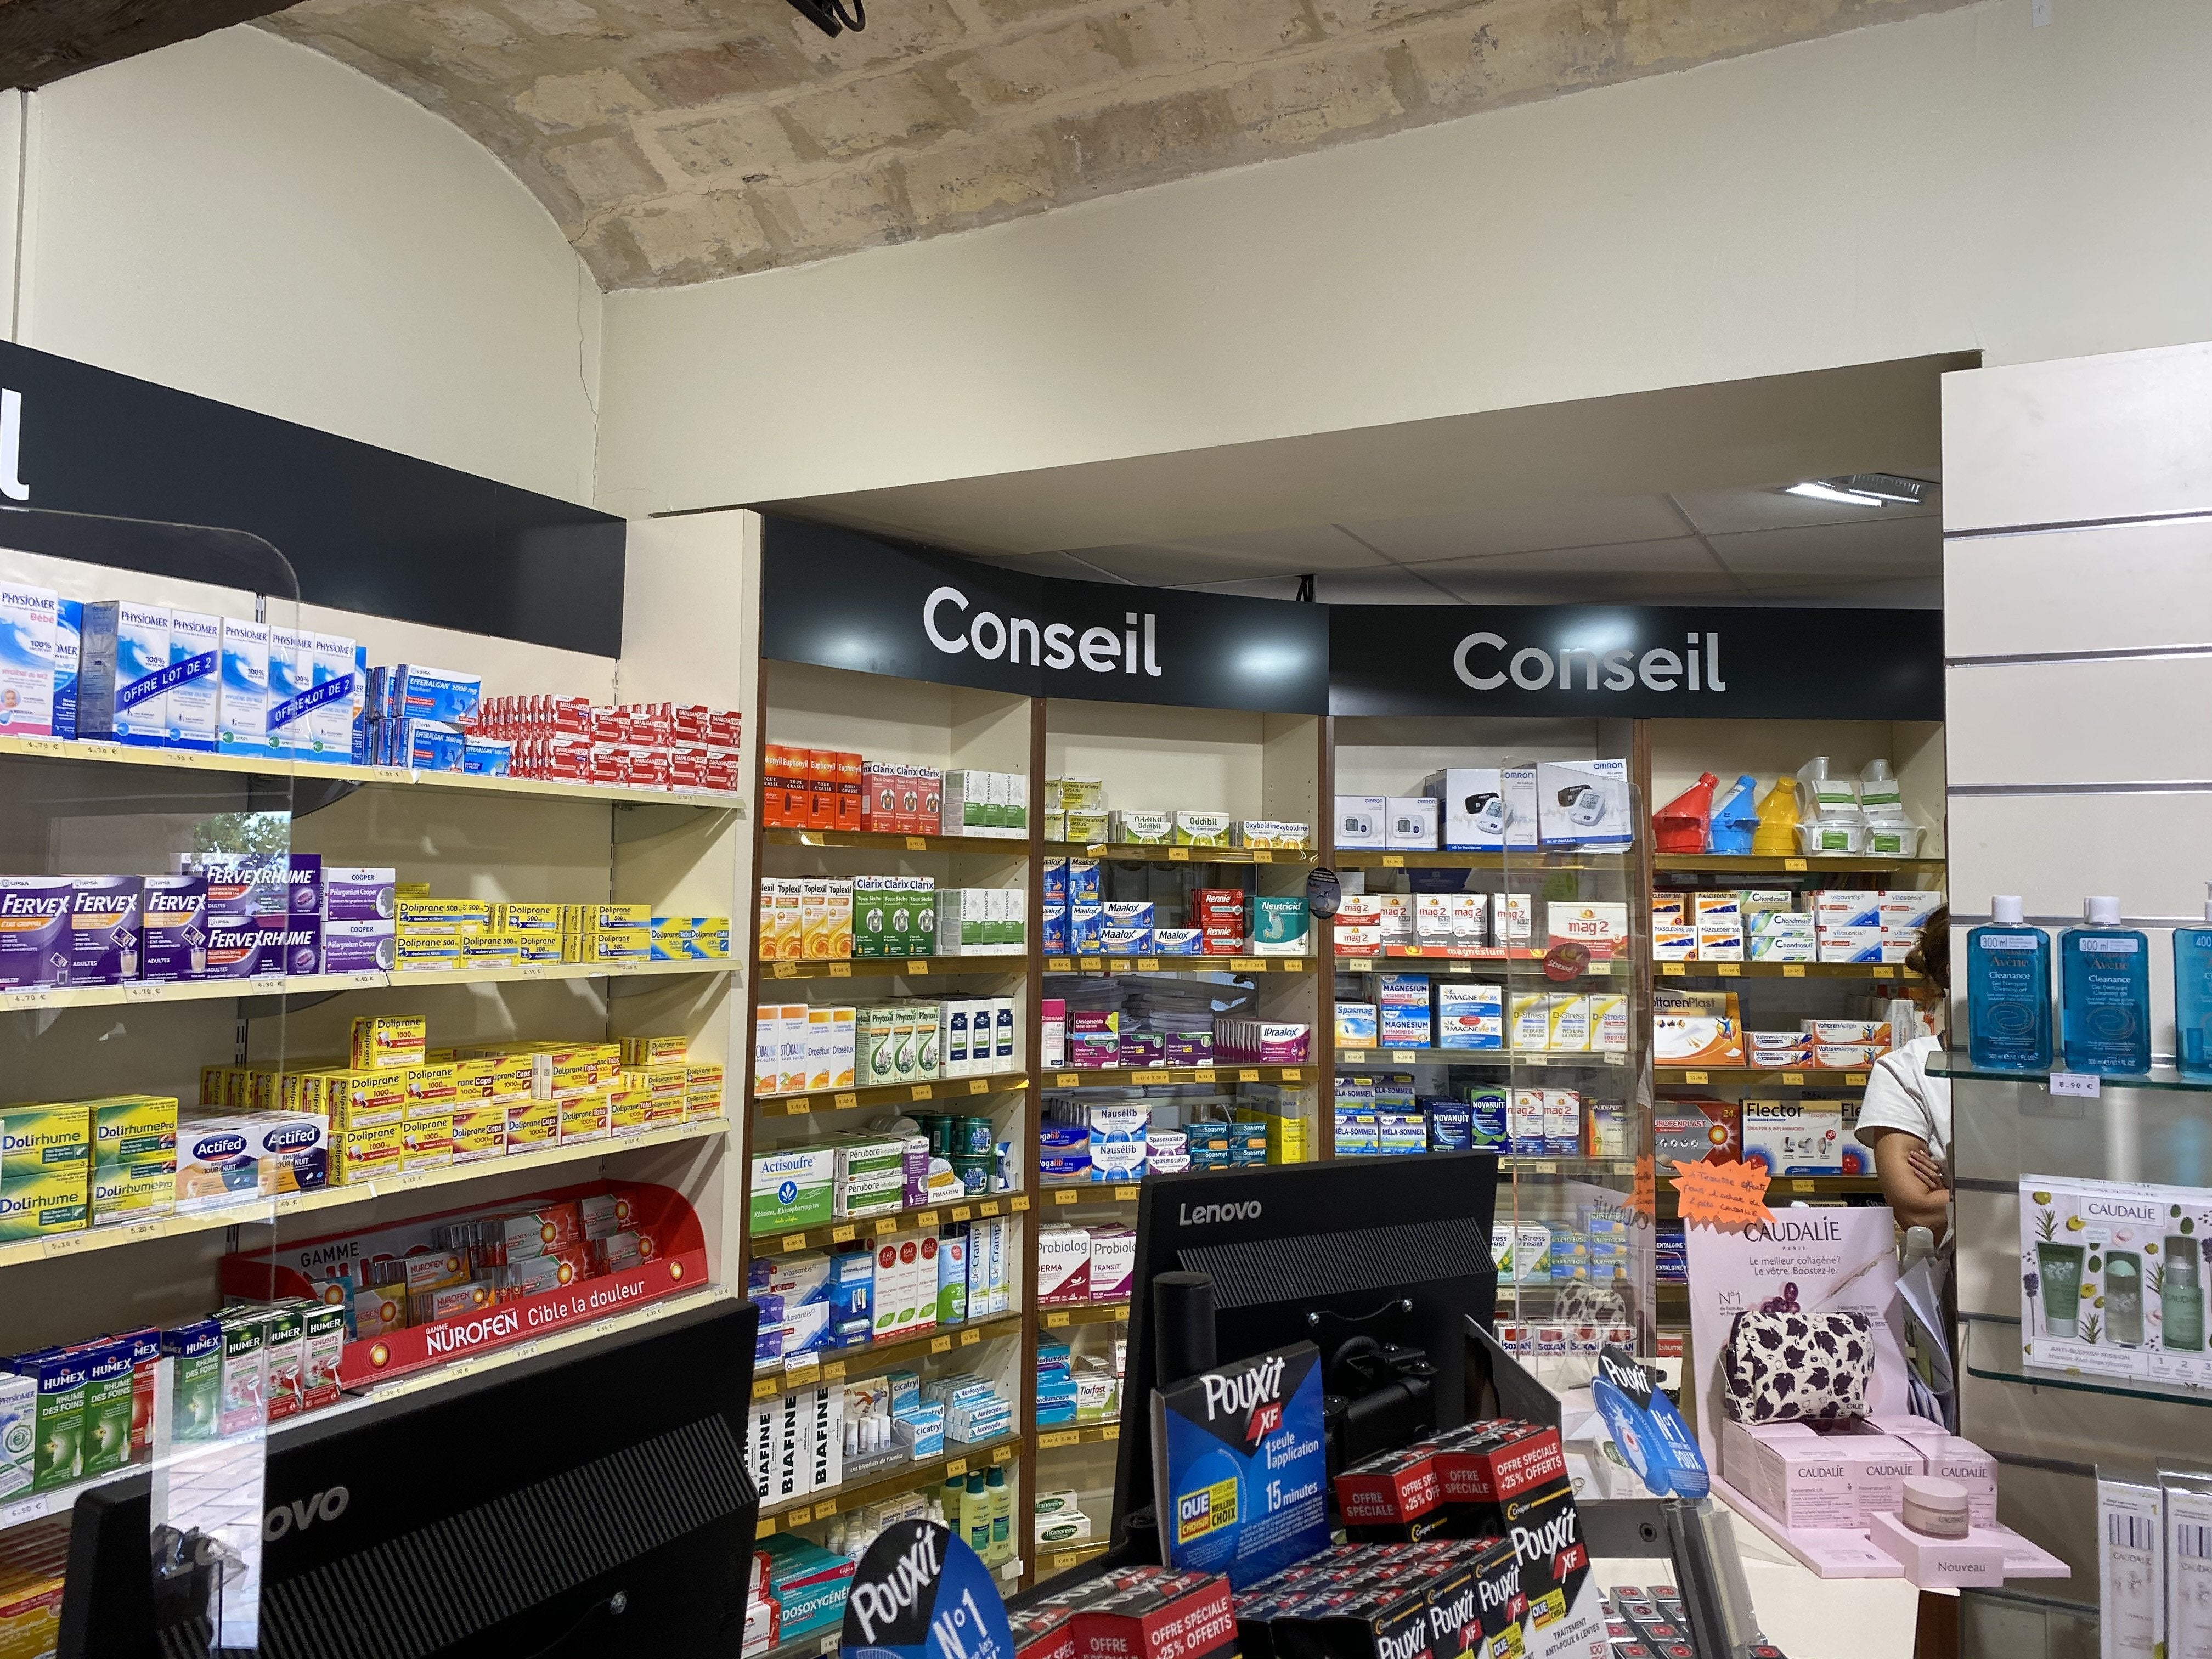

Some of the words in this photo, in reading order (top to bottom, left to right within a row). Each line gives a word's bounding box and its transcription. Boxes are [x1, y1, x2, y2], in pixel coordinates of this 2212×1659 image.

[30, 612, 55, 624] Bébé
[923, 586, 1161, 676] Conseil
[31, 640, 52, 650] 100%
[1453, 631, 1725, 691] Conseil
[123, 680, 157, 702] OFFRE
[162, 668, 182, 685] LOT
[187, 662, 201, 676] DE
[205, 657, 211, 669] 2
[410, 677, 449, 690] EFFERALGAN
[452, 684, 466, 693] 1000
[467, 687, 477, 695] mg
[275, 703, 304, 721] OFFRE
[308, 693, 325, 709] LOT
[328, 685, 342, 697] DE
[344, 679, 350, 690] 2
[466, 747, 493, 755] EFFERALGAN
[873, 765, 894, 774] Clarix
[1190, 817, 1217, 826] Oddibil
[1245, 821, 1279, 830] Oxyboldine
[330, 888, 358, 898] Pélargonium
[360, 888, 377, 896] Cooper
[778, 885, 801, 895] Toplexil
[2, 894, 69, 915] FERVEX
[74, 893, 137, 912] FERVEX
[1206, 895, 1231, 904] Rennie
[1752, 893, 1788, 903] Chondrosulf
[400, 903, 445, 913] Doliprane
[510, 906, 550, 915] Doliprane
[1108, 904, 1138, 912] Maalox
[1262, 901, 1301, 911] Neutricid
[1345, 904, 1361, 913] mag
[1207, 927, 1231, 936] Rennie
[1983, 938, 1997, 947] 300
[1999, 938, 2008, 947] ml
[1447, 947, 1505, 957] magnésium
[1990, 955, 2028, 967] Avène
[1338, 1006, 1373, 1015] Spasmag
[1514, 1011, 1545, 1019] D-Stress
[872, 1013, 894, 1024] Phytoxil
[808, 1047, 830, 1056] Drosétux
[1102, 1109, 1137, 1119] Nausélib
[1434, 1111, 1469, 1123] NOVANUIT
[1747, 1103, 1803, 1117] Flector
[268, 1129, 316, 1146] Actifed
[452, 1127, 486, 1138] Doliprane
[487, 1124, 503, 1133] Caps
[1383, 1127, 1425, 1136] MÉLA-SOMMEIL
[3, 1131, 81, 1149] Dolirhume
[198, 1139, 242, 1154] Actifed
[850, 1148, 880, 1159] Pérubore
[880, 1146, 901, 1154] inhalation
[761, 1157, 812, 1173] Actisoufre
[1180, 1200, 1261, 1226] Lenovo
[300, 1242, 360, 1268] GAMME
[882, 1251, 895, 1260] RAP
[1750, 1257, 1759, 1265] Le
[1797, 1256, 1836, 1266] collagène
[410, 1260, 444, 1273] NUROFEN
[783, 1265, 812, 1276] vitasantis
[438, 1291, 470, 1305] NUROFEN
[426, 1311, 518, 1356] NUROFEN
[528, 1300, 567, 1327] Cible
[571, 1299, 586, 1315] la
[590, 1279, 645, 1311] douleur
[229, 1337, 260, 1353] HUMER
[312, 1336, 338, 1347] SINUSITE
[93, 1358, 131, 1377] HUMEX
[44, 1370, 85, 1390] HUMEX
[104, 1379, 131, 1392] RHUME
[894, 1379, 918, 1391] cicatryl
[91, 1392, 106, 1403] DES
[108, 1386, 131, 1400] FOINS
[961, 1385, 985, 1396] Auréocyde
[1080, 1384, 1105, 1396] Tiorfast
[55, 1391, 85, 1405] RHUME
[42, 1405, 58, 1415] DES
[60, 1399, 84, 1413] FOINS
[916, 1422, 941, 1435] cicatryl
[1256, 1408, 1279, 1446] XF
[816, 1387, 828, 1485] BIAFINE
[781, 1395, 797, 1495] BIAFINE
[1265, 1443, 1271, 1470] 1
[1272, 1431, 1295, 1450] seule
[1272, 1440, 1319, 1469] application
[1497, 1459, 1522, 1476] OFFRE
[1523, 1443, 1558, 1468] SPÉCIALE
[1673, 1449, 1702, 1470] POUX
[860, 1459, 877, 1471] bienfaits
[885, 1453, 902, 1465] l'Arnica
[1500, 1472, 1524, 1491] +25%
[1526, 1457, 1562, 1481] OFFERTS
[1266, 1480, 1281, 1513] 15
[1283, 1482, 1318, 1505] minutes
[1352, 1492, 1383, 1504] OFFRE
[1182, 1494, 1209, 1520] QUE
[1347, 1503, 1395, 1517] SPÉCIALE
[1513, 1503, 1530, 1516] Cooper
[1212, 1506, 1235, 1527] CHOIX
[1182, 1516, 1209, 1535] CHOISIR
[1938, 1562, 1985, 1572] Nouveau
[1152, 1618, 1184, 1642] OFFRE
[1184, 1596, 1228, 1631] SPÉCIALE
[1187, 1613, 1232, 1647] OFFERTS
[1553, 1618, 1587, 1640] TRAITEMENT
[1545, 1635, 1575, 1658] ANTI-POUX
[1576, 1633, 1581, 1641] &
[1582, 1623, 1600, 1639] LENTES
